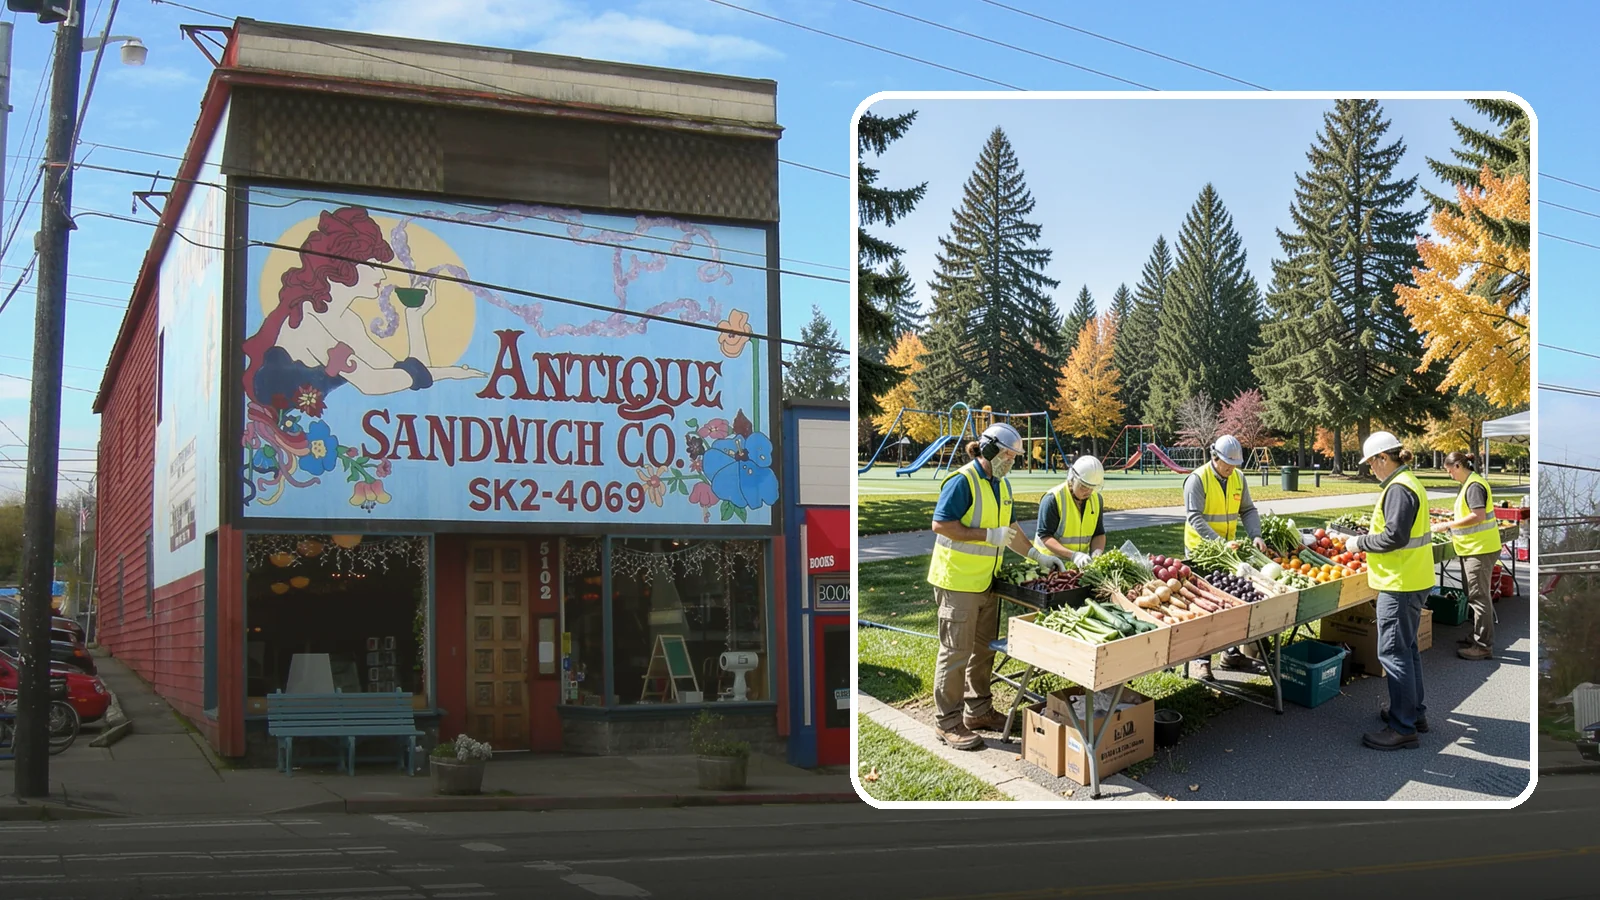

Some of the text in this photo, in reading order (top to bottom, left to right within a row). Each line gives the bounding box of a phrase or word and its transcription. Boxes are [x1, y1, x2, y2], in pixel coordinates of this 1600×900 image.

[475, 328, 724, 421] ANTIQUE
[361, 408, 685, 469] SANDWICH CO.
[468, 476, 646, 514] SK2-4069
[539, 541, 551, 600] 5102
[809, 555, 835, 569] BOOKS
